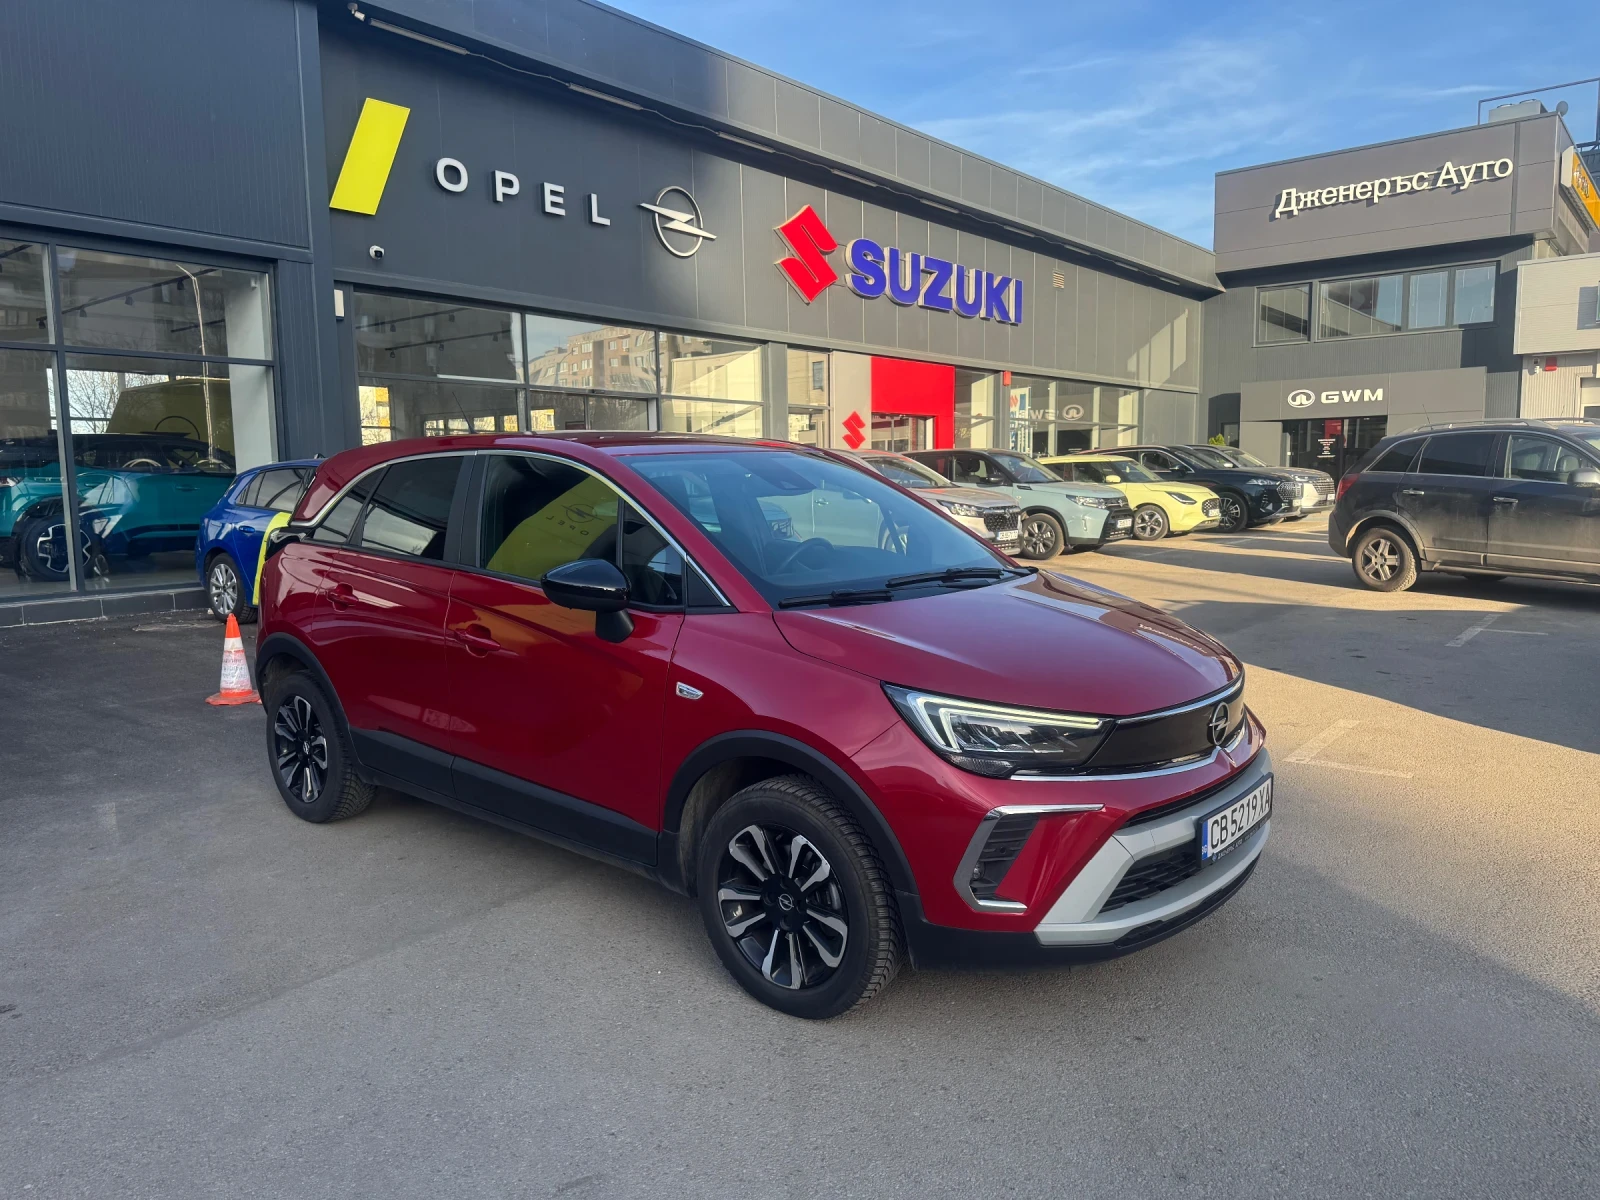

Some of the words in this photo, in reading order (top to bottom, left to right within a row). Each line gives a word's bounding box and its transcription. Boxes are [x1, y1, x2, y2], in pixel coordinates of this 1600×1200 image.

[435, 157, 611, 227] OPEL
[1275, 169, 1429, 218] Дженеръс
[1437, 157, 1514, 195] Ауто
[844, 237, 1024, 326] SUZUKI
[1320, 388, 1384, 404] GWM
[1230, 793, 1258, 838] 5219
